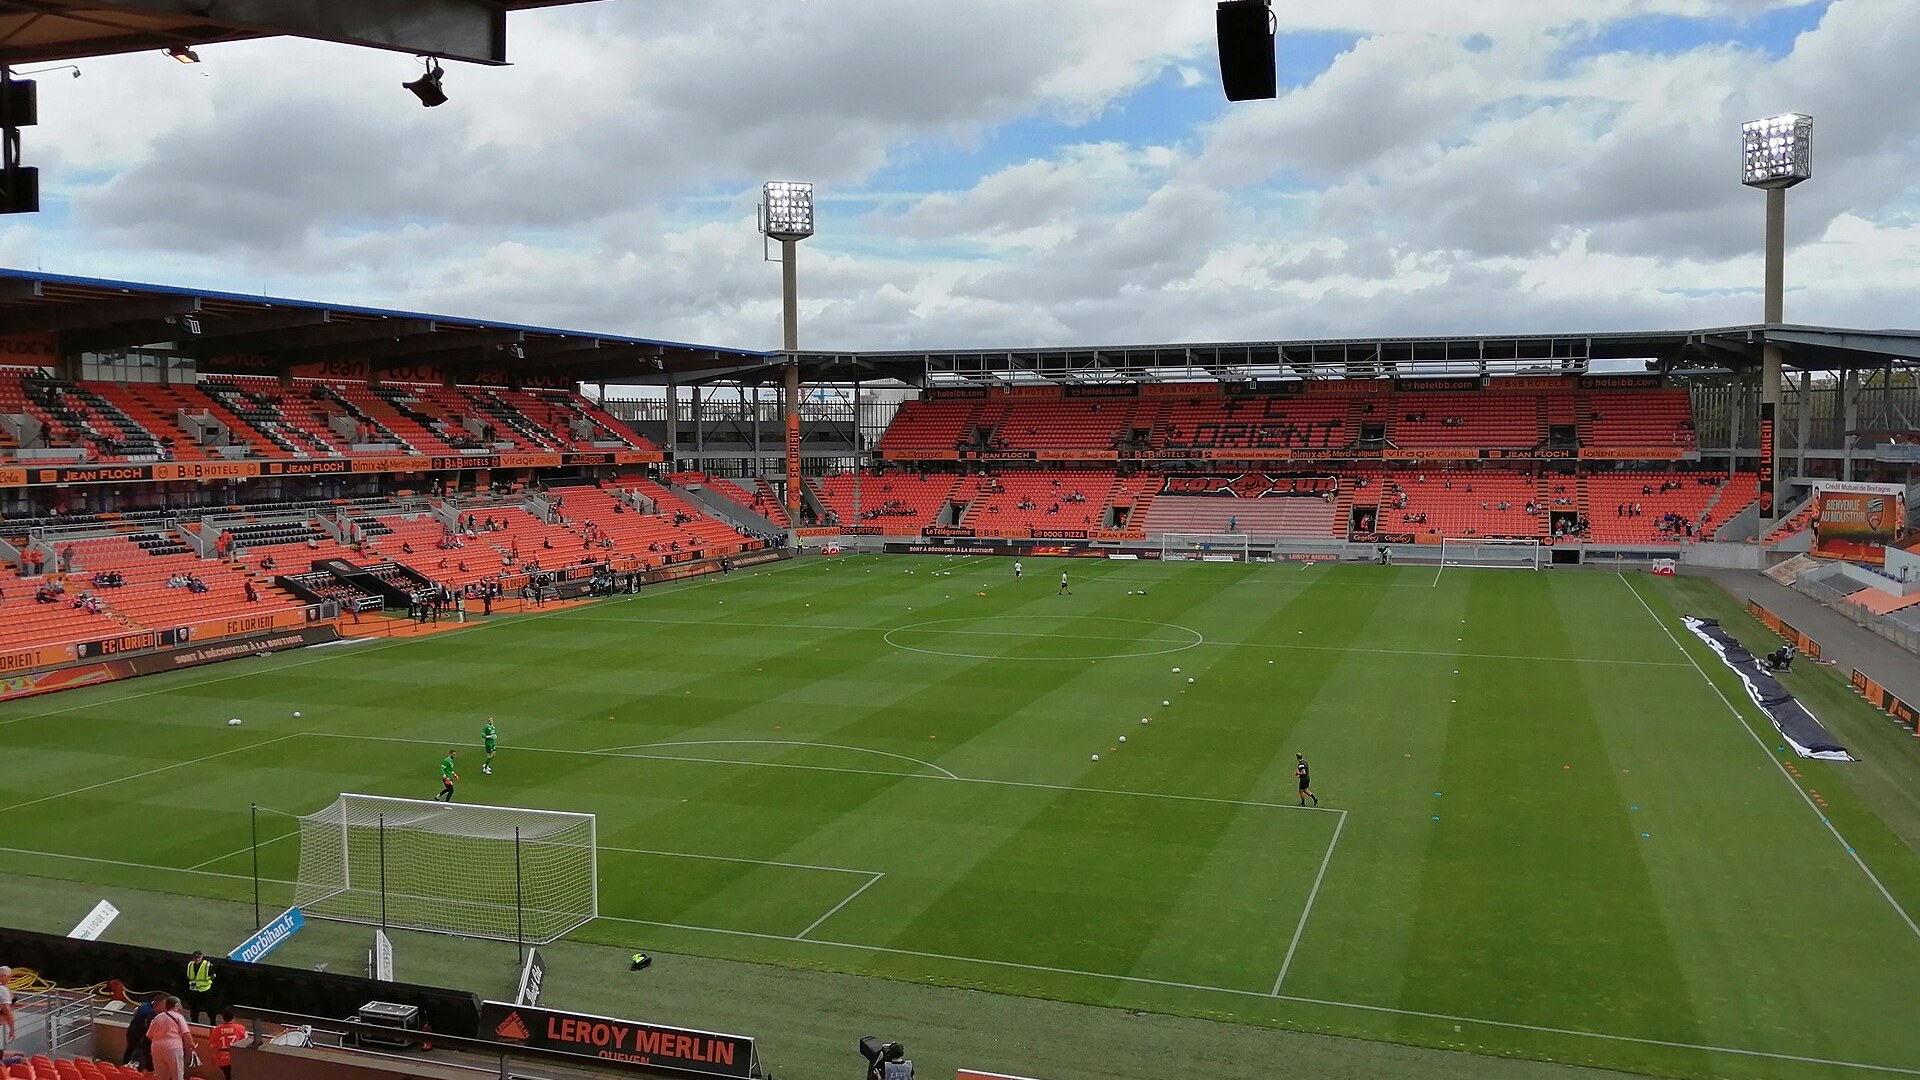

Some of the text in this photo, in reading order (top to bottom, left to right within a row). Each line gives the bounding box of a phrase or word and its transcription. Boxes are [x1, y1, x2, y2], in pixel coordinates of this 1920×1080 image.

[1332, 381, 1368, 390] HOTELS
[1414, 380, 1472, 389] hotelbb.com
[1504, 378, 1566, 387] B&B HOTELS
[1595, 377, 1653, 387] hotelbb.com
[789, 427, 799, 478] FC LORIENT
[907, 451, 944, 459] Kappa
[1135, 451, 1155, 459] B&B
[1386, 450, 1435, 458] virage
[1506, 451, 1532, 459] JEAN
[286, 463, 311, 474] JEAN
[445, 458, 489, 468] B&B HOTELS
[63, 470, 97, 482] JEAN
[178, 465, 239, 478] B&B HOTELS
[1760, 467, 1771, 481] FC
[1867, 485, 1891, 493] Bretagne
[1826, 500, 1860, 511] BIENVENUE
[1820, 511, 1865, 522] AU MOUSTOIR
[934, 528, 972, 536] Télégramme
[984, 529, 1000, 537] B&B
[568, 567, 593, 580] FC LORIENT
[228, 615, 274, 634] FC LORIENT
[102, 633, 163, 655] FC LORIENT
[175, 634, 304, 664] SONT À DÉCOUVRIR À LA BOUTIQUE
[242, 915, 294, 962] morbihan.fr
[219, 1034, 237, 1049] 17
[547, 1016, 735, 1066] LEROY MERLIN
